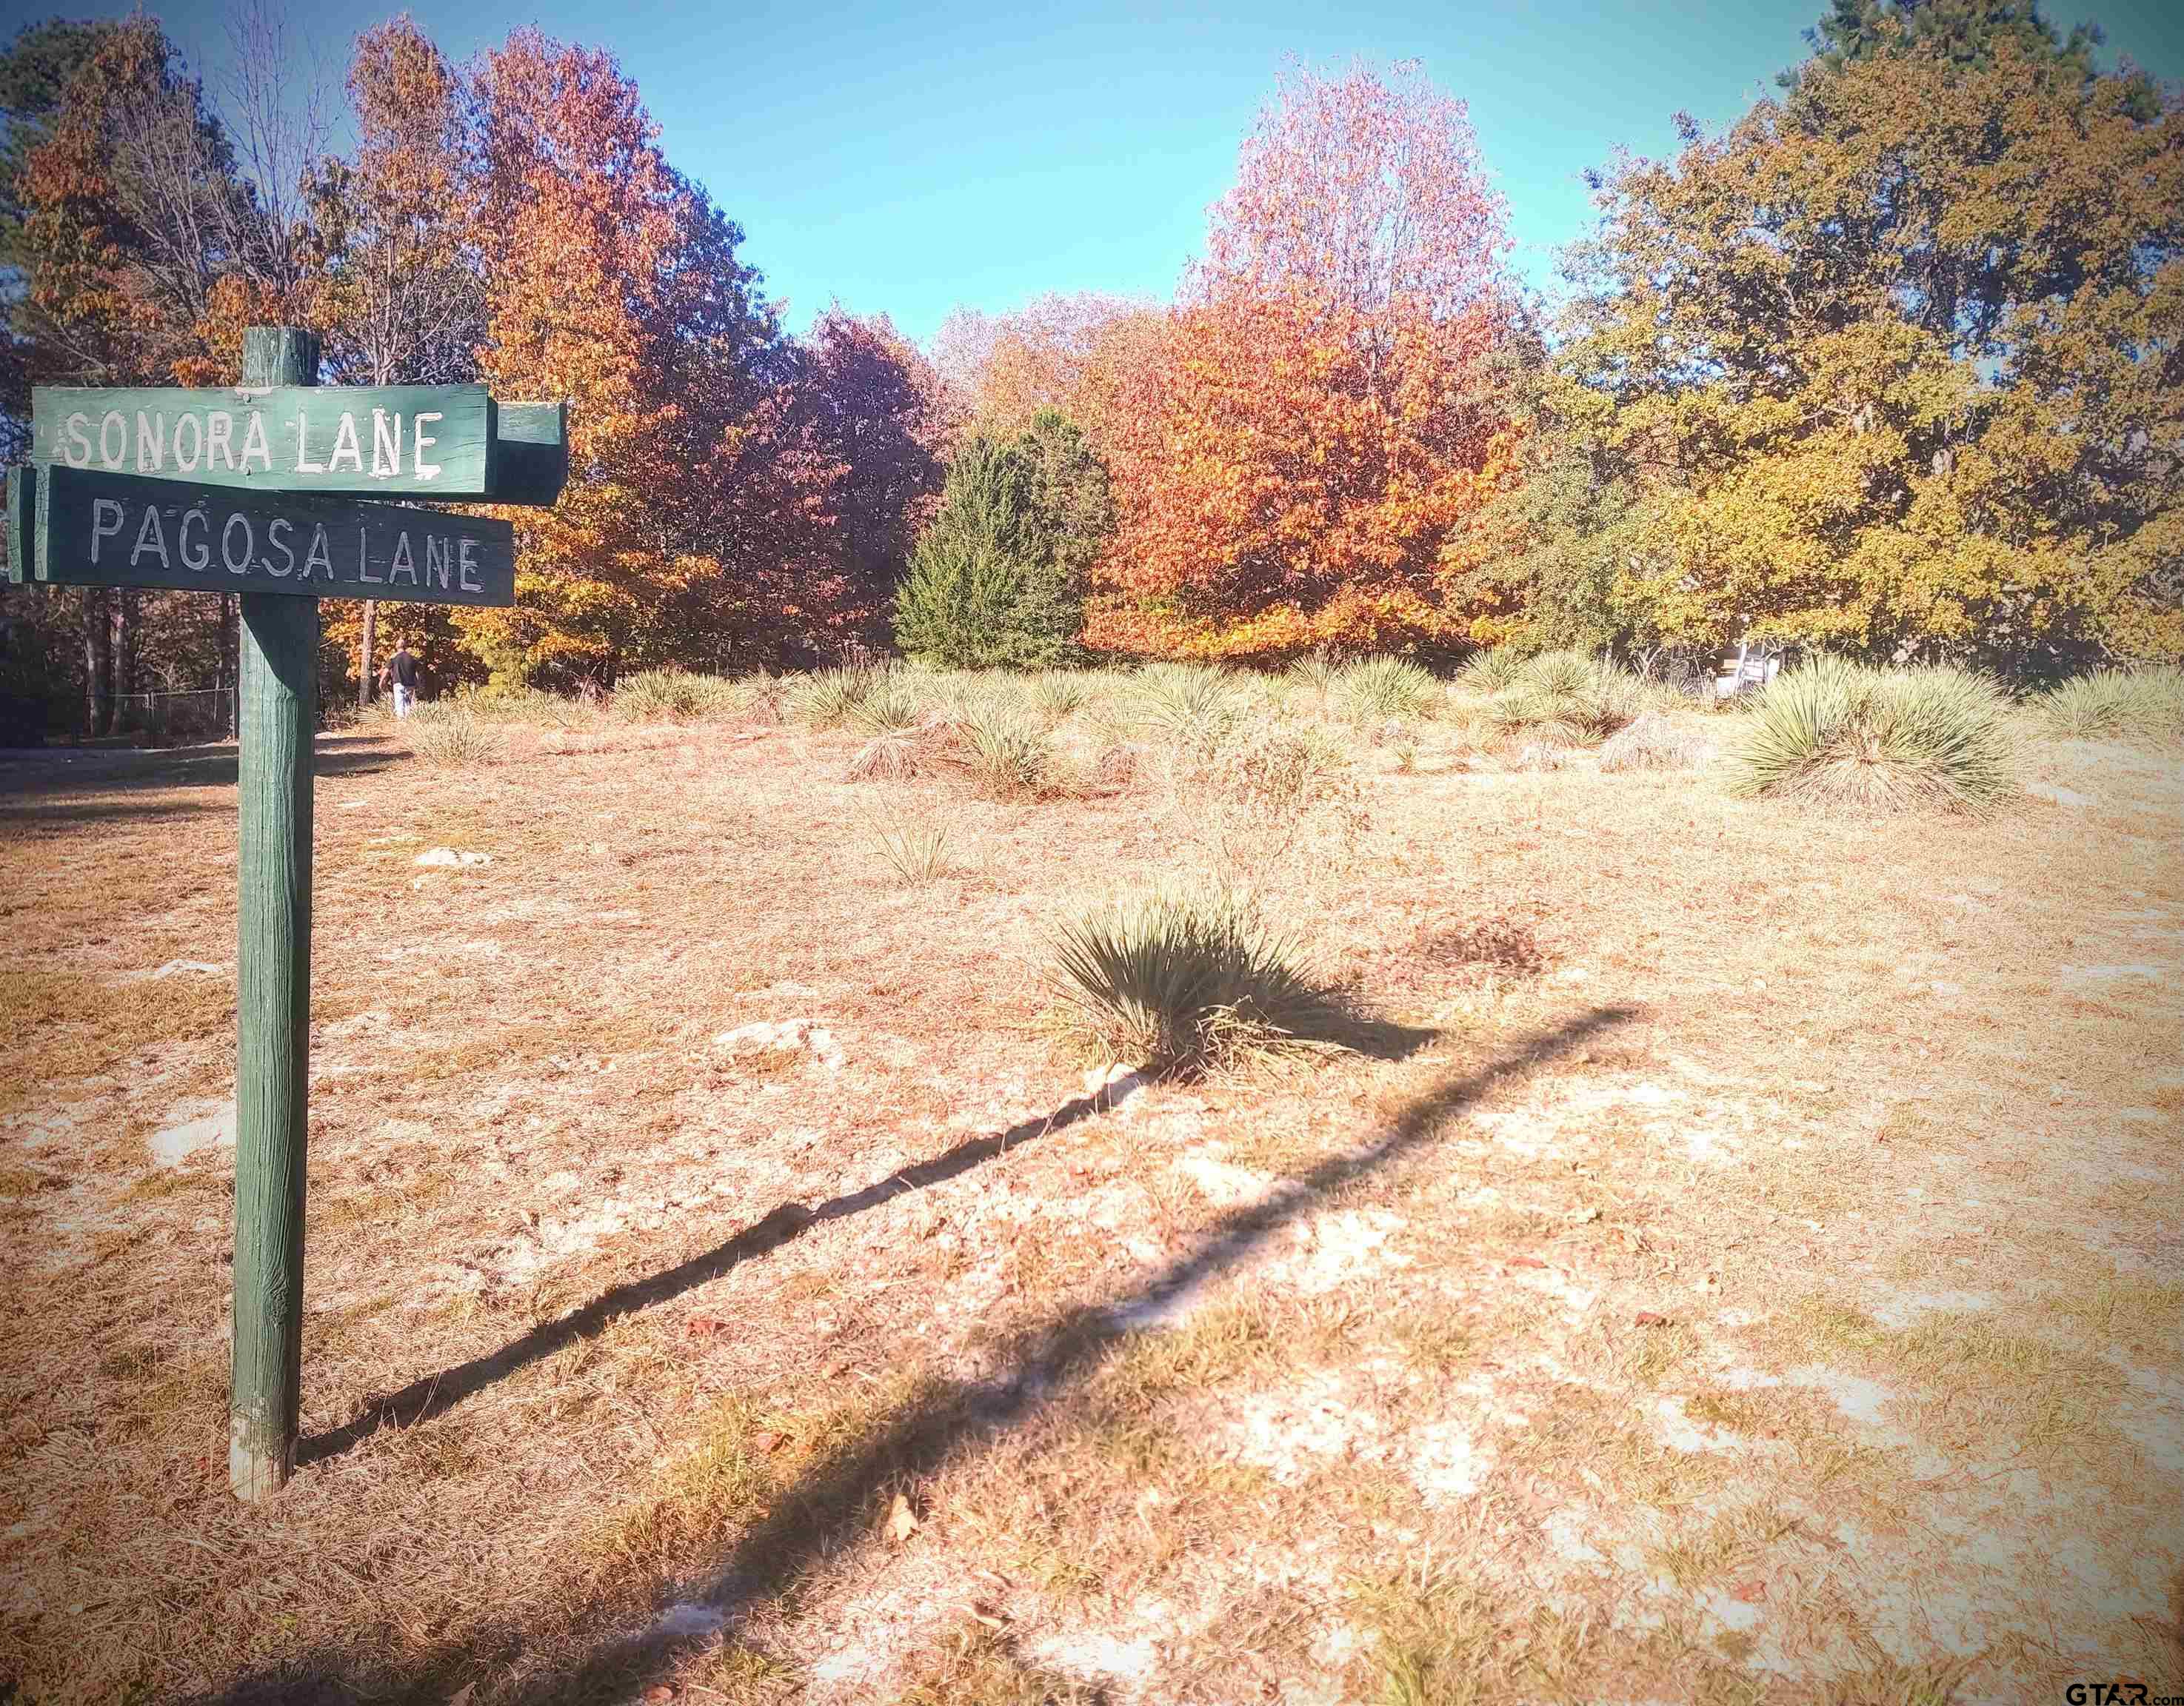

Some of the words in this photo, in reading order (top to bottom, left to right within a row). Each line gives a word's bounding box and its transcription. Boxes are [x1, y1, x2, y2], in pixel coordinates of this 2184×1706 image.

[62, 409, 272, 472] SONORA
[295, 408, 444, 480] LANE
[90, 498, 334, 580] PAGOSA
[358, 526, 485, 592] LANE
